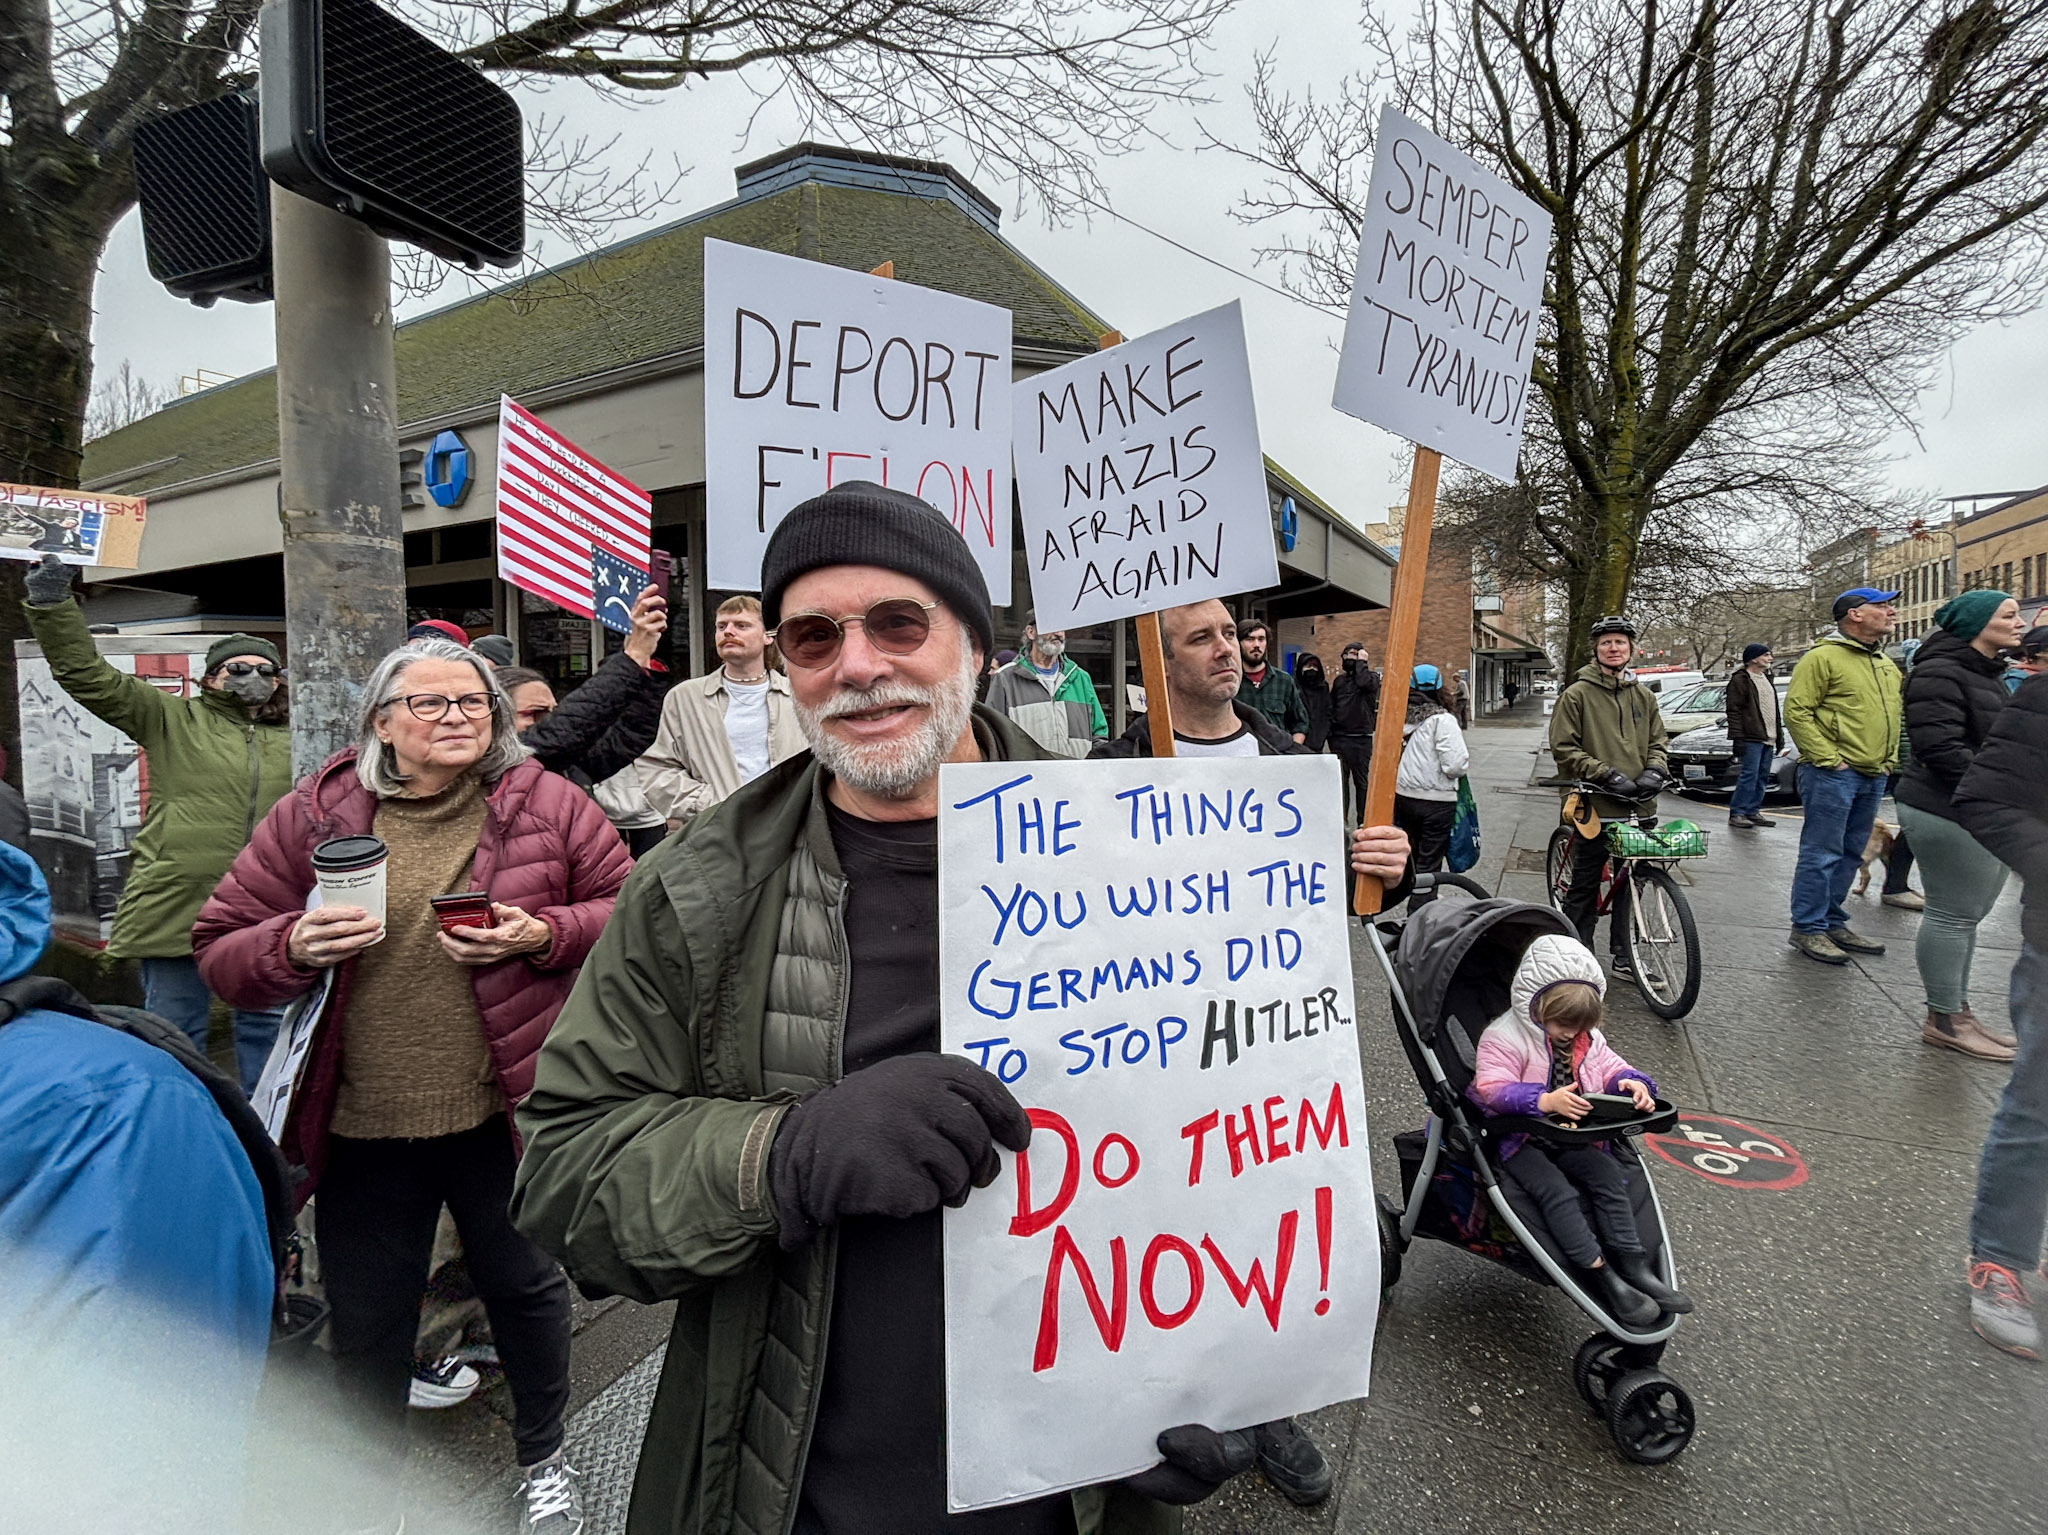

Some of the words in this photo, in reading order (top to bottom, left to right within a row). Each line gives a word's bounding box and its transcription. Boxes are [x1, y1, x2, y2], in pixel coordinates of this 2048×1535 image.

[1386, 139, 1529, 282] SEMPER
[1377, 228, 1530, 362] MORTEM
[733, 307, 999, 431] DEPORT
[1038, 336, 1203, 454] MAKE
[1372, 300, 1527, 436] TYRANIS!
[1064, 425, 1216, 508] NAZIS
[1041, 489, 1207, 571] AFRAID
[1072, 522, 1223, 611] AGAIN
[953, 774, 1082, 864] THE
[1115, 784, 1302, 845] THINGS
[981, 882, 1087, 946] YOU
[1107, 869, 1230, 917] WISH
[1247, 859, 1327, 908] THE
[967, 949, 1202, 1020] GERMANS
[1224, 928, 1302, 982] DID
[963, 1037, 1028, 1084] TO
[1058, 1016, 1188, 1076] STOP
[1180, 1081, 1350, 1187] THEM
[1033, 1185, 1333, 1373] NOW!
